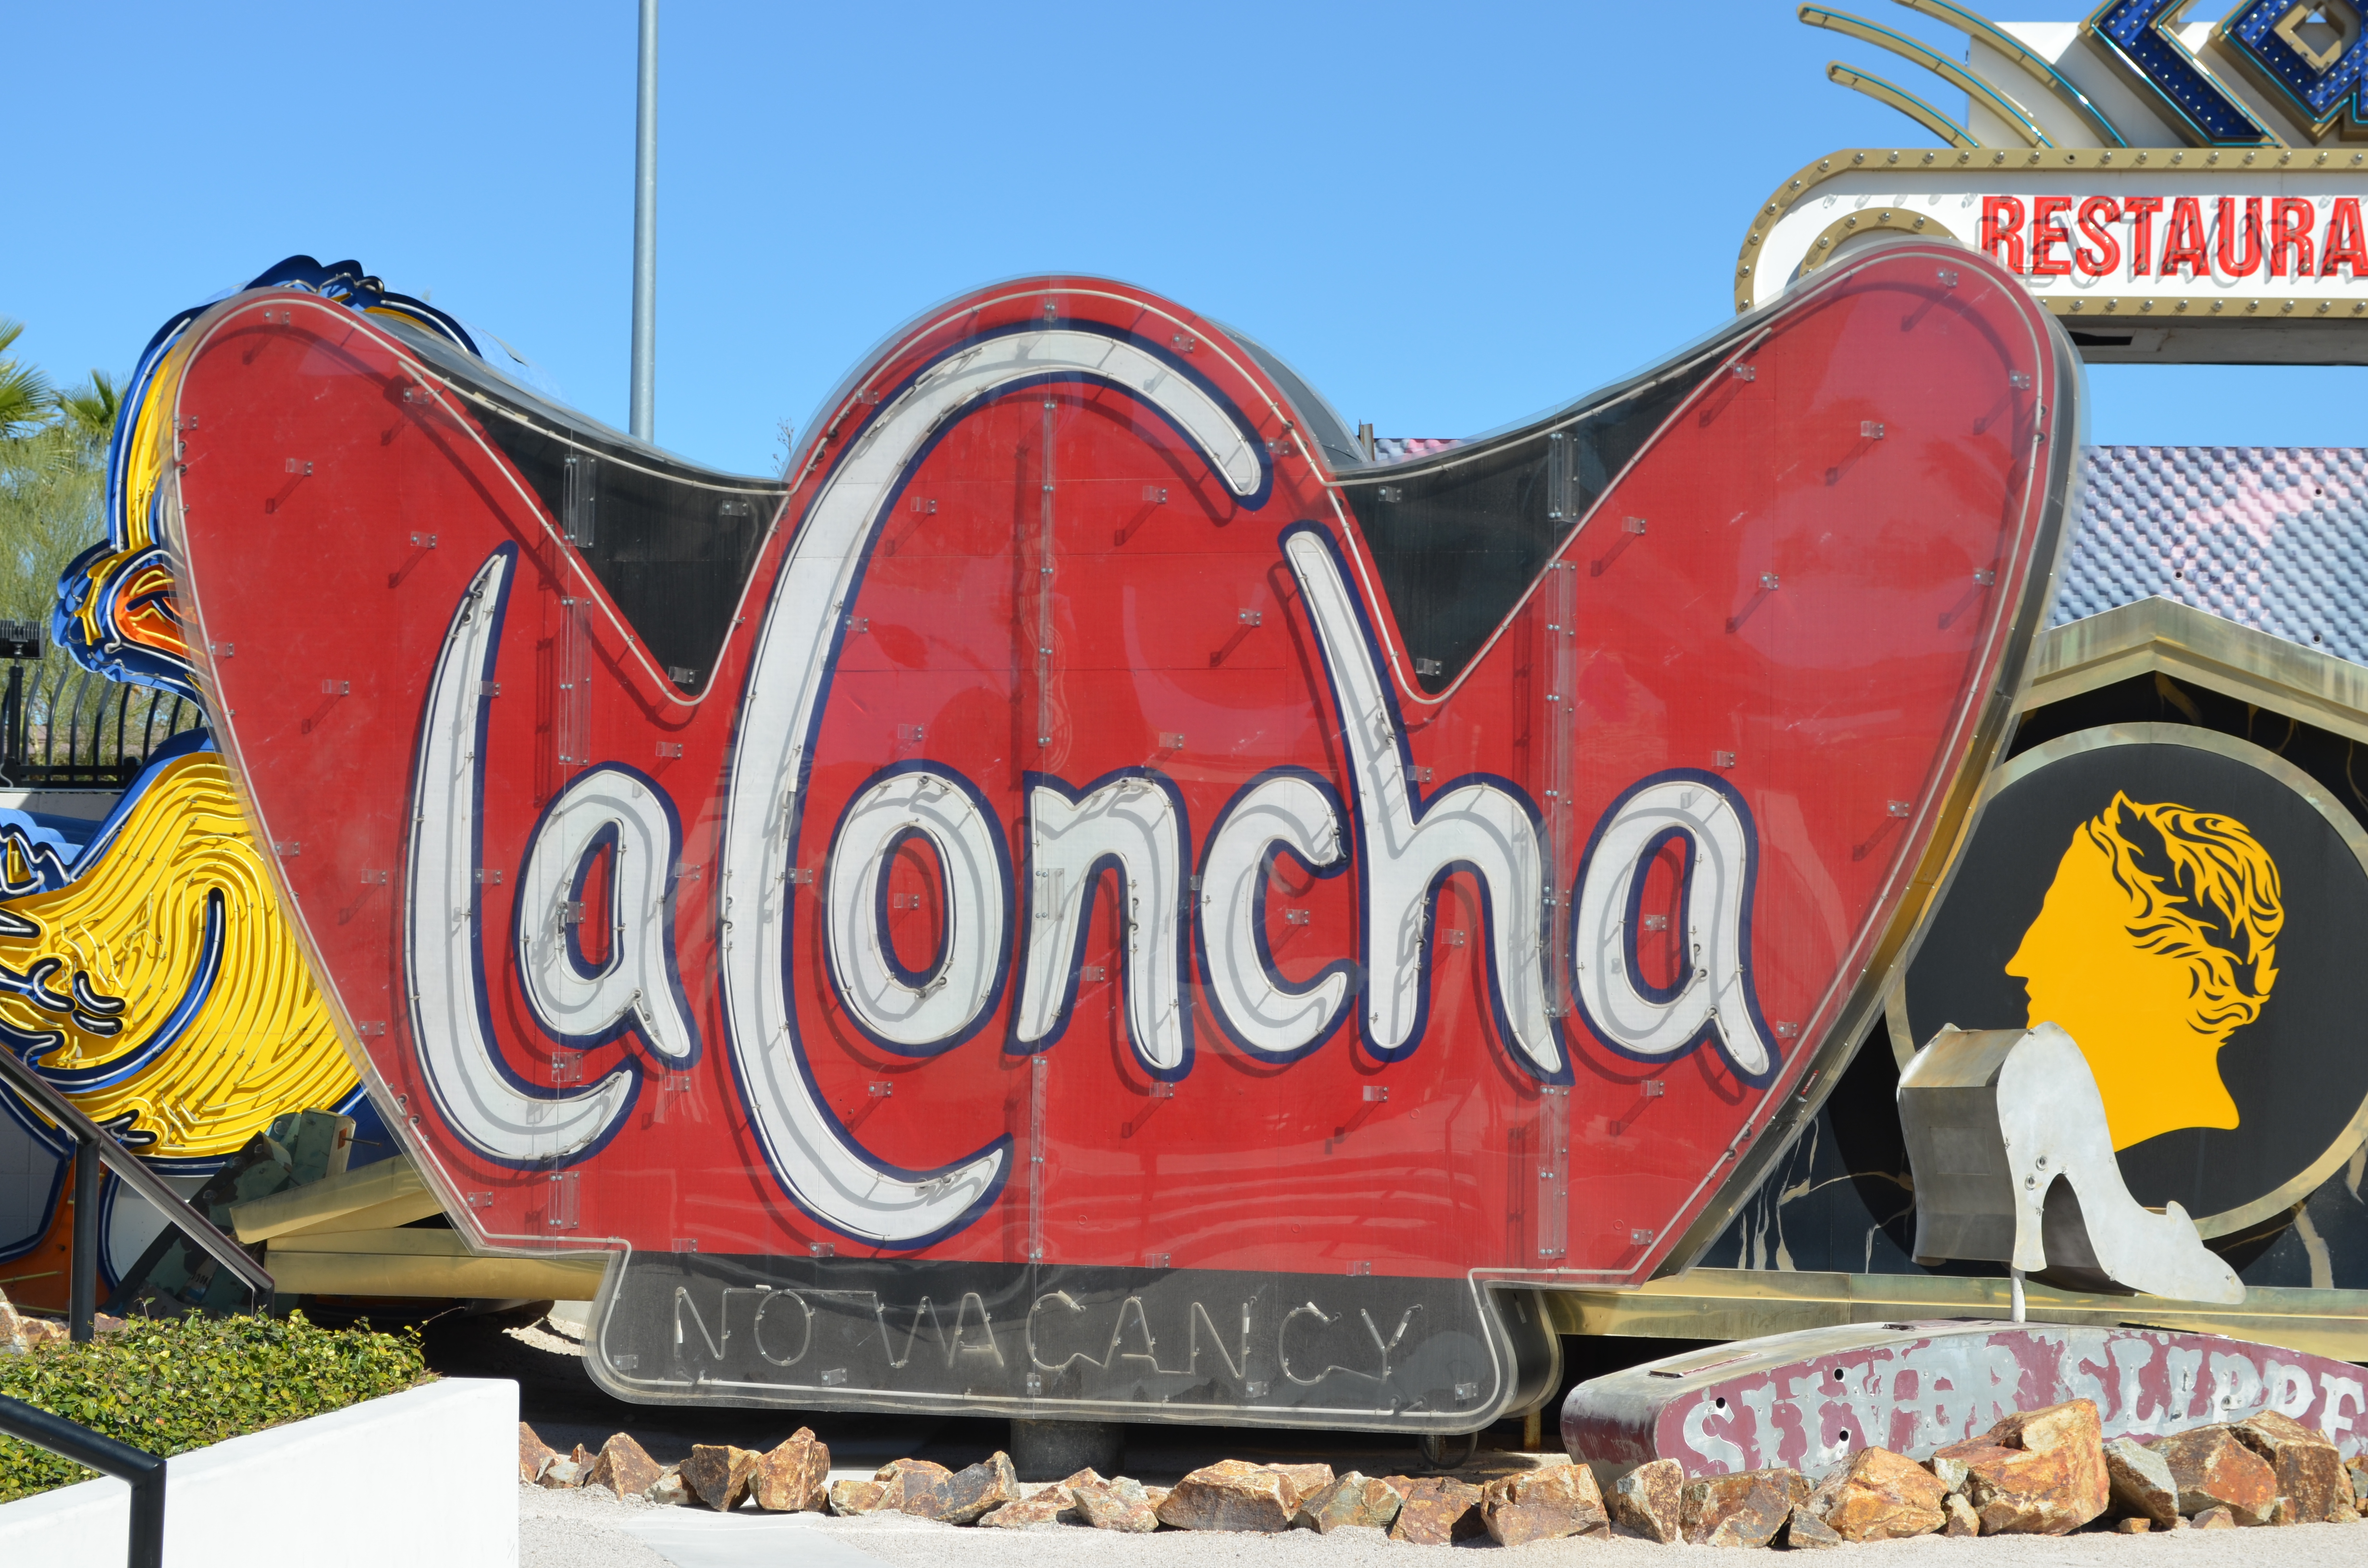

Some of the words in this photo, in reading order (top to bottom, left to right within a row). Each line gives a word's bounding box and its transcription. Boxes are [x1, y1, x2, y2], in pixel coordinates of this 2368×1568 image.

[1982, 196, 2368, 277] RESTAURA
[722, 319, 1781, 1245] Concha
[674, 1286, 813, 1367] NO
[872, 1289, 1415, 1386] VACANCY
